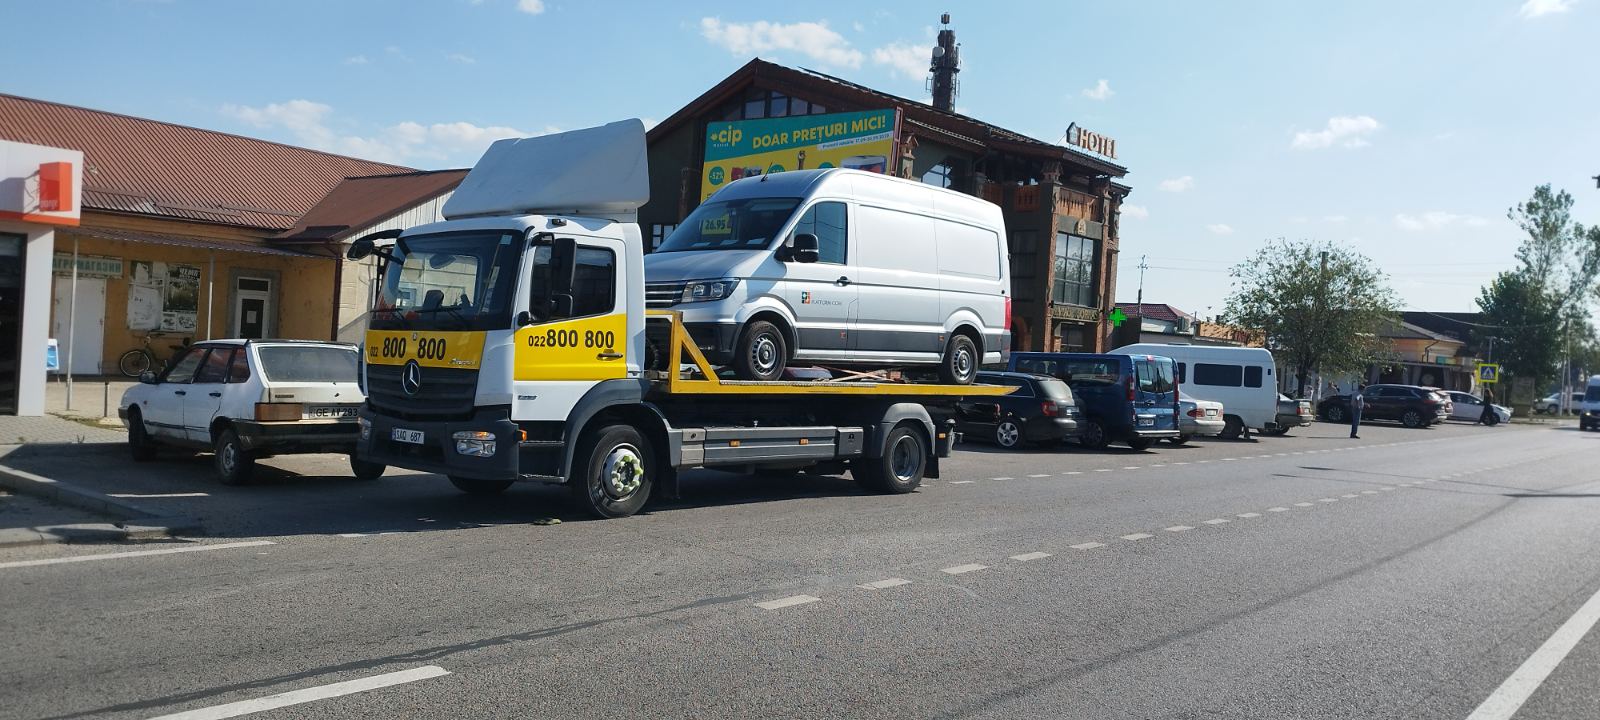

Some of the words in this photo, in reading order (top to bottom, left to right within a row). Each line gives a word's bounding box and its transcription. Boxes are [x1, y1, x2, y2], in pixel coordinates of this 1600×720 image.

[719, 125, 742, 147] cip
[752, 132, 788, 149] DOAR
[792, 122, 847, 142] PREȚURI
[851, 115, 886, 133] MICI!
[1079, 128, 1117, 159] HOTEL
[369, 346, 379, 357] 022
[382, 337, 407, 358] 800
[417, 338, 446, 360] 800
[585, 330, 614, 348] 800
[315, 408, 328, 417] GE
